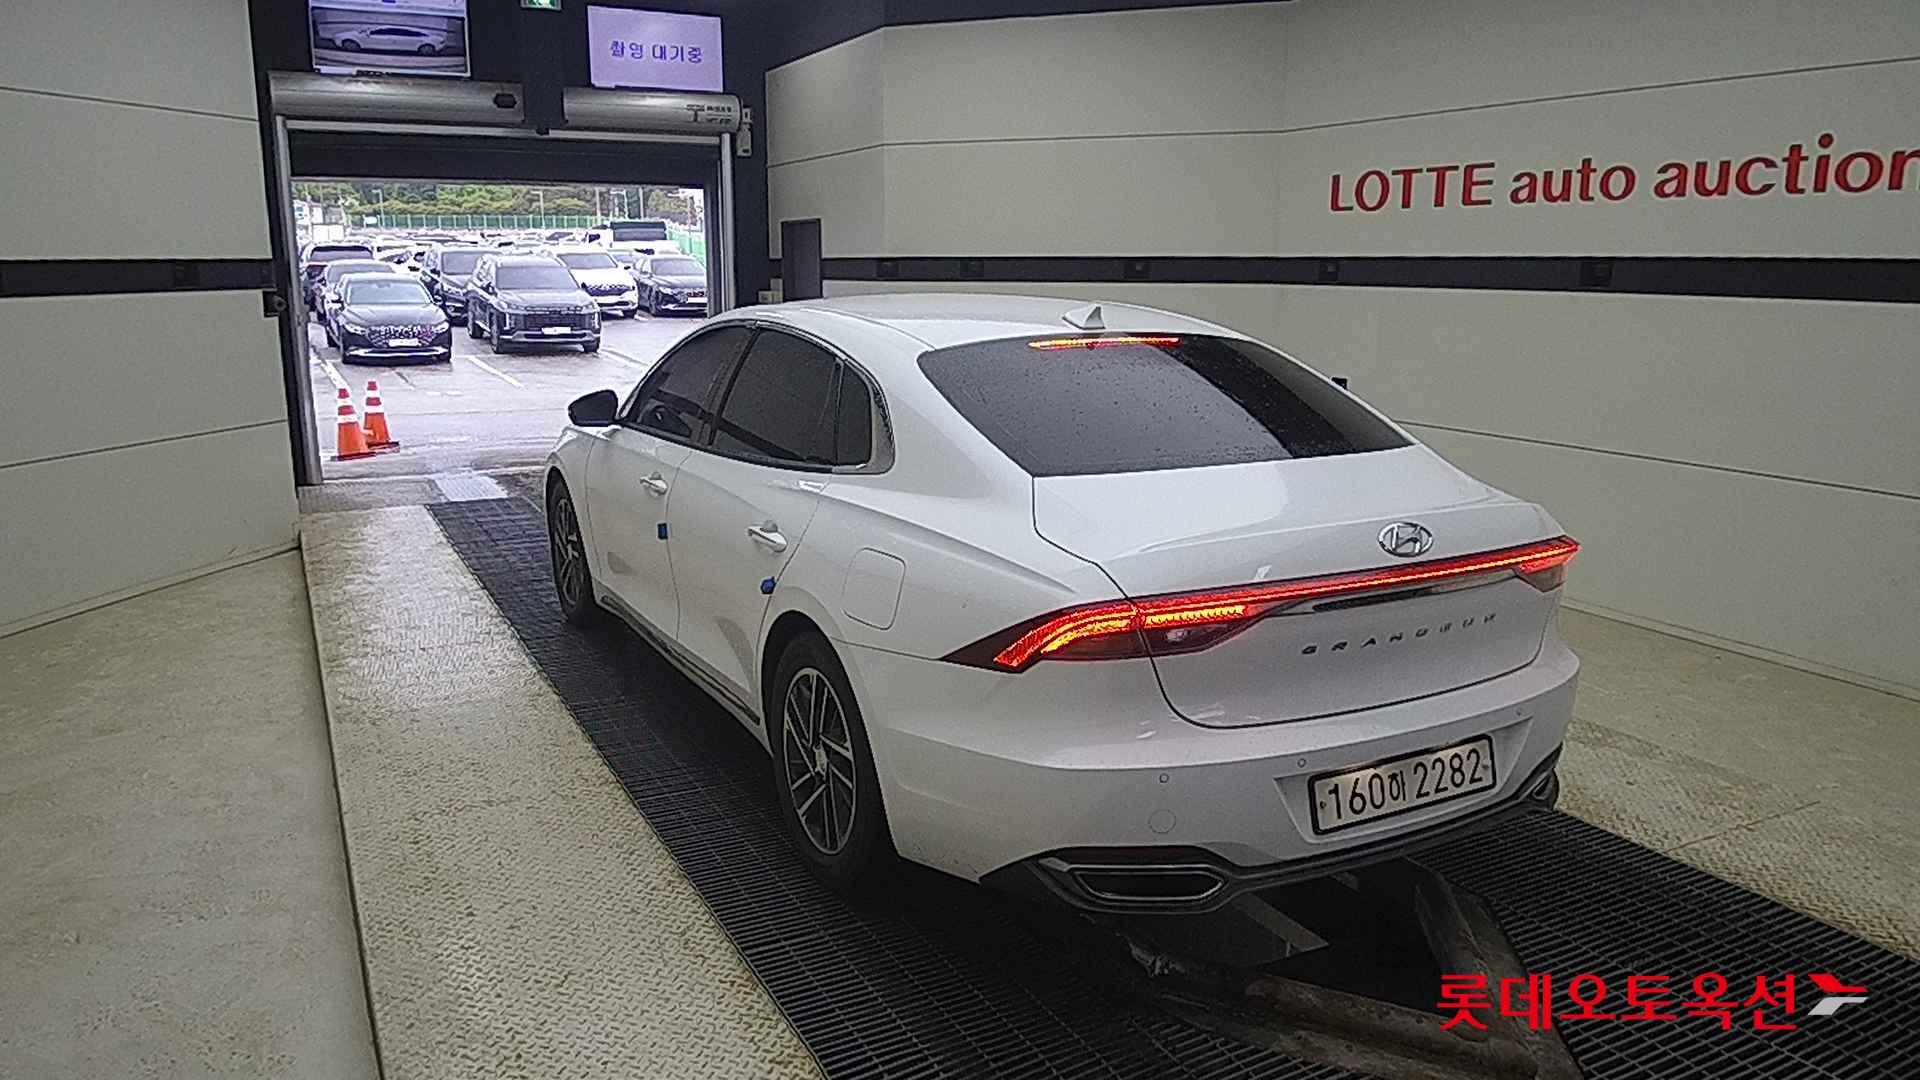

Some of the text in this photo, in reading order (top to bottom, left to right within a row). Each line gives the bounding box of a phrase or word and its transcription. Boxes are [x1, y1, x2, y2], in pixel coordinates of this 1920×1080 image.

[610, 40, 702, 64] 촬영 대기중
[1330, 132, 1920, 212] LOTTE auto auction
[1301, 613, 1496, 655] GRANDEUR
[1413, 748, 1482, 799] 2282
